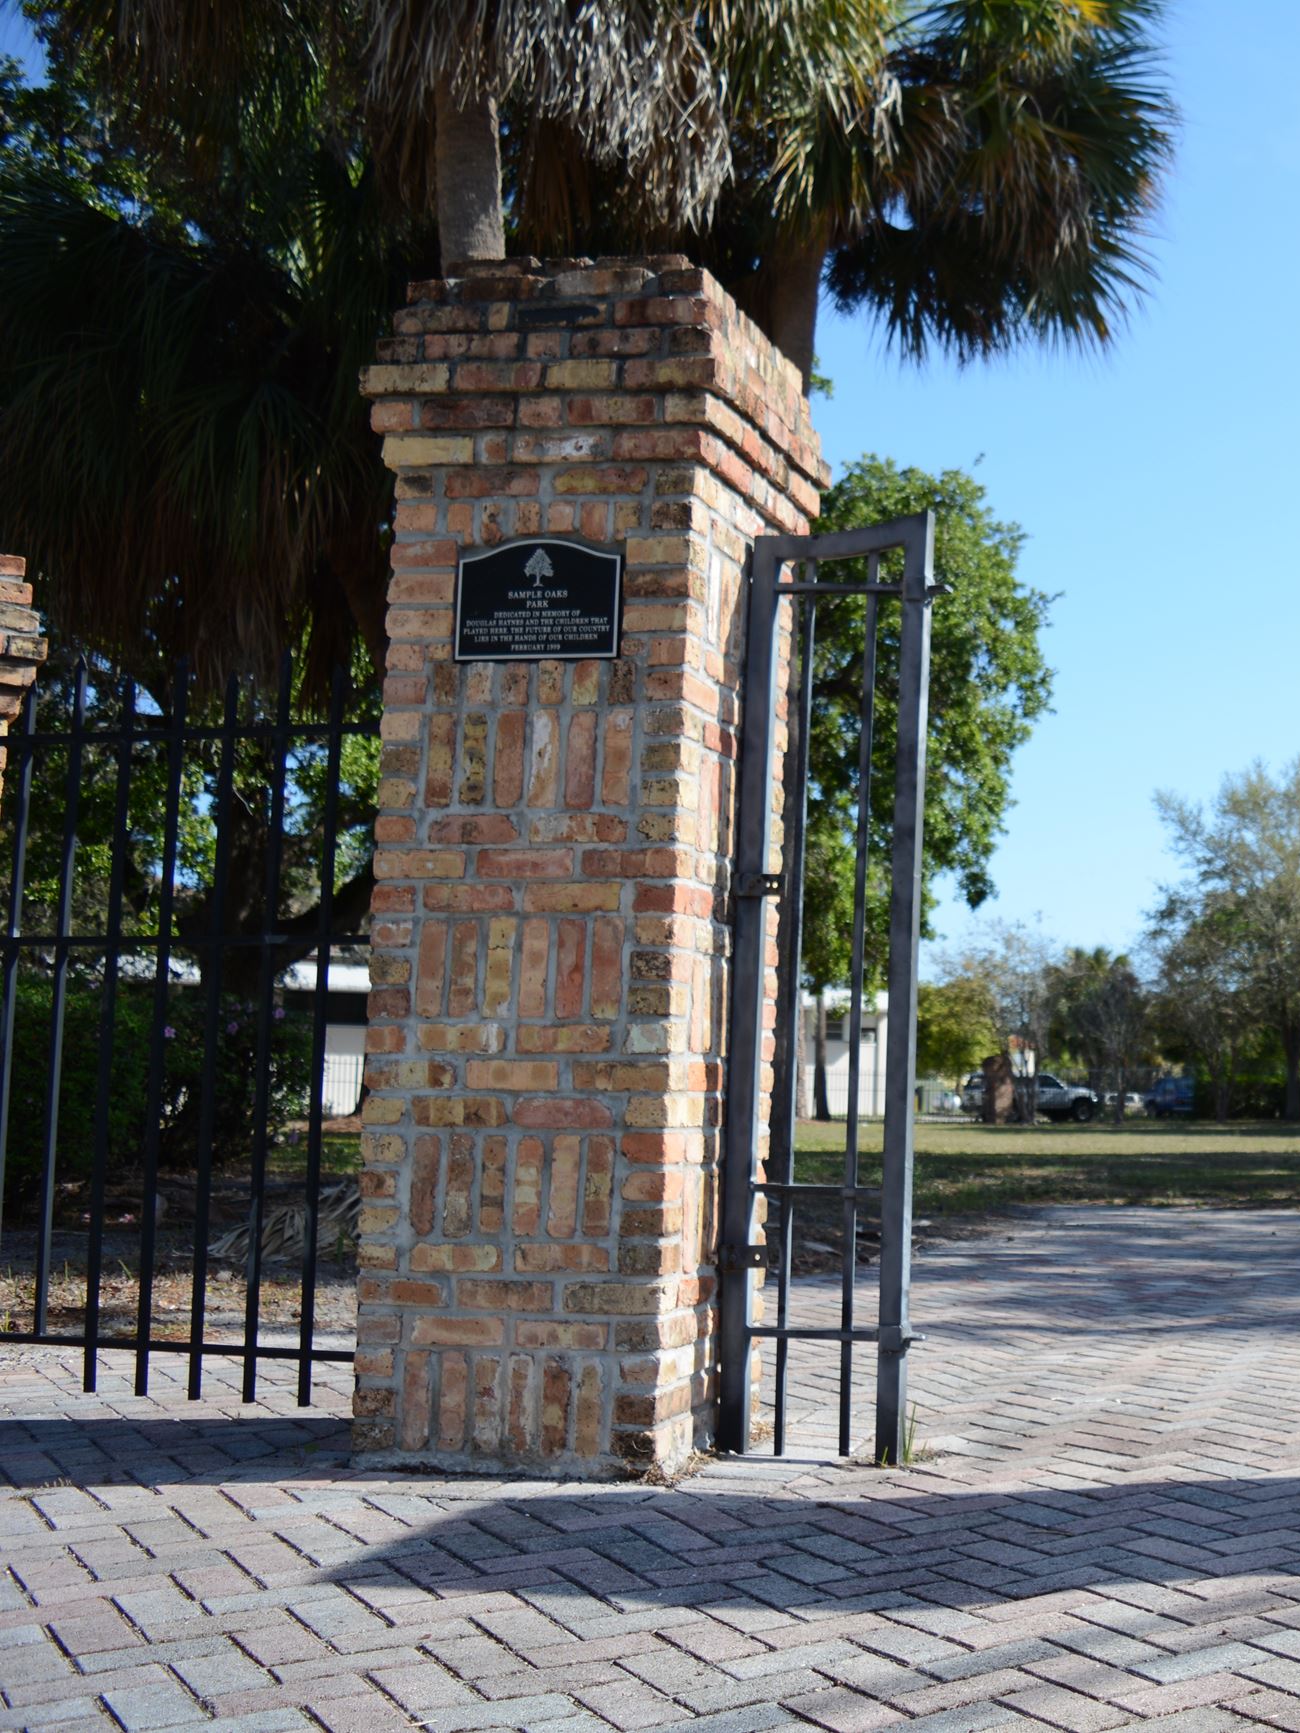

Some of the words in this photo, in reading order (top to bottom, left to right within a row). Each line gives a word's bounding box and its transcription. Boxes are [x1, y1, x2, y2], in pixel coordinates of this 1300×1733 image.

[508, 590, 543, 599] SAMPLE
[544, 590, 568, 599] OAKS
[526, 600, 549, 608] PARK
[494, 611, 532, 619] DEDICATED
[563, 633, 598, 641] CHILDREN
[511, 644, 545, 652] FEBRUARY
